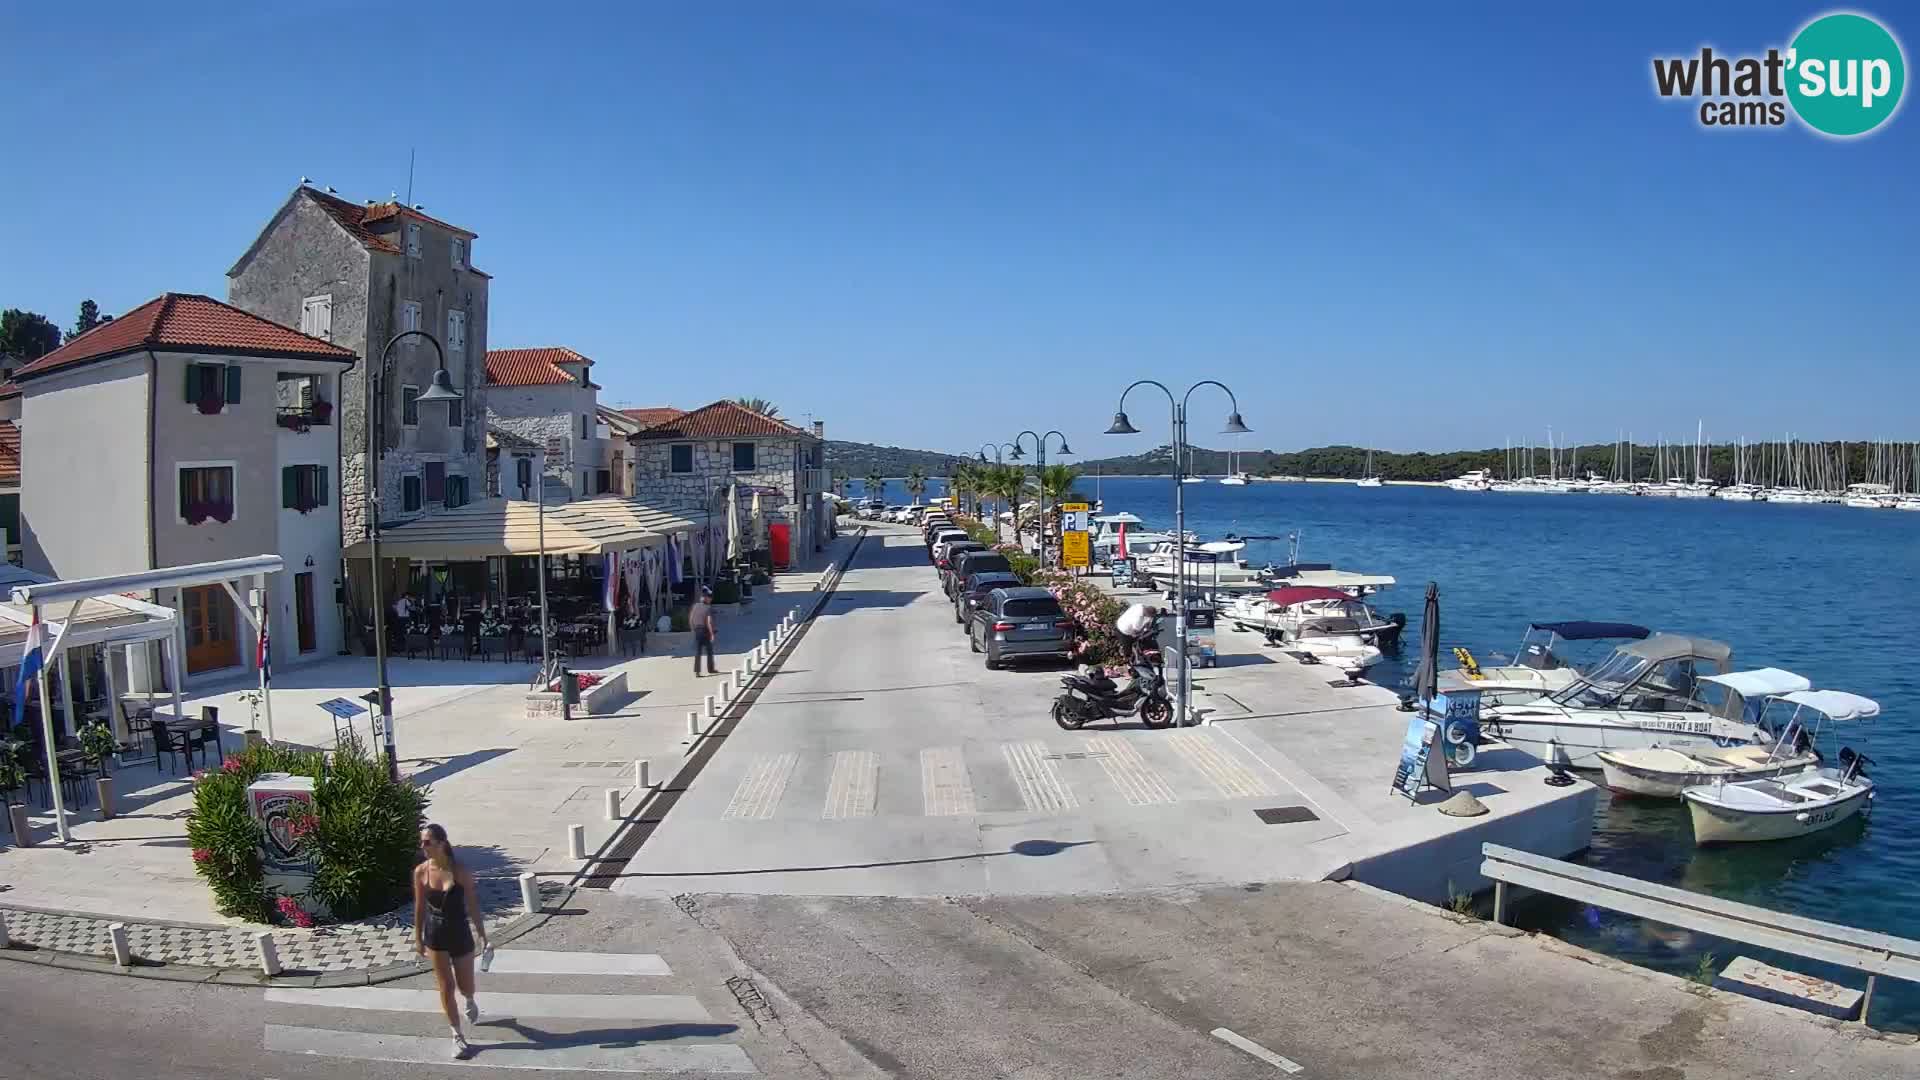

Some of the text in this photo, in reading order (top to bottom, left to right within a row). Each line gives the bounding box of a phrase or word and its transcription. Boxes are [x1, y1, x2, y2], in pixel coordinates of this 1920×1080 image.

[1666, 721, 1686, 731] RENT
[1687, 721, 1693, 732] A
[1694, 722, 1712, 732] BOAT
